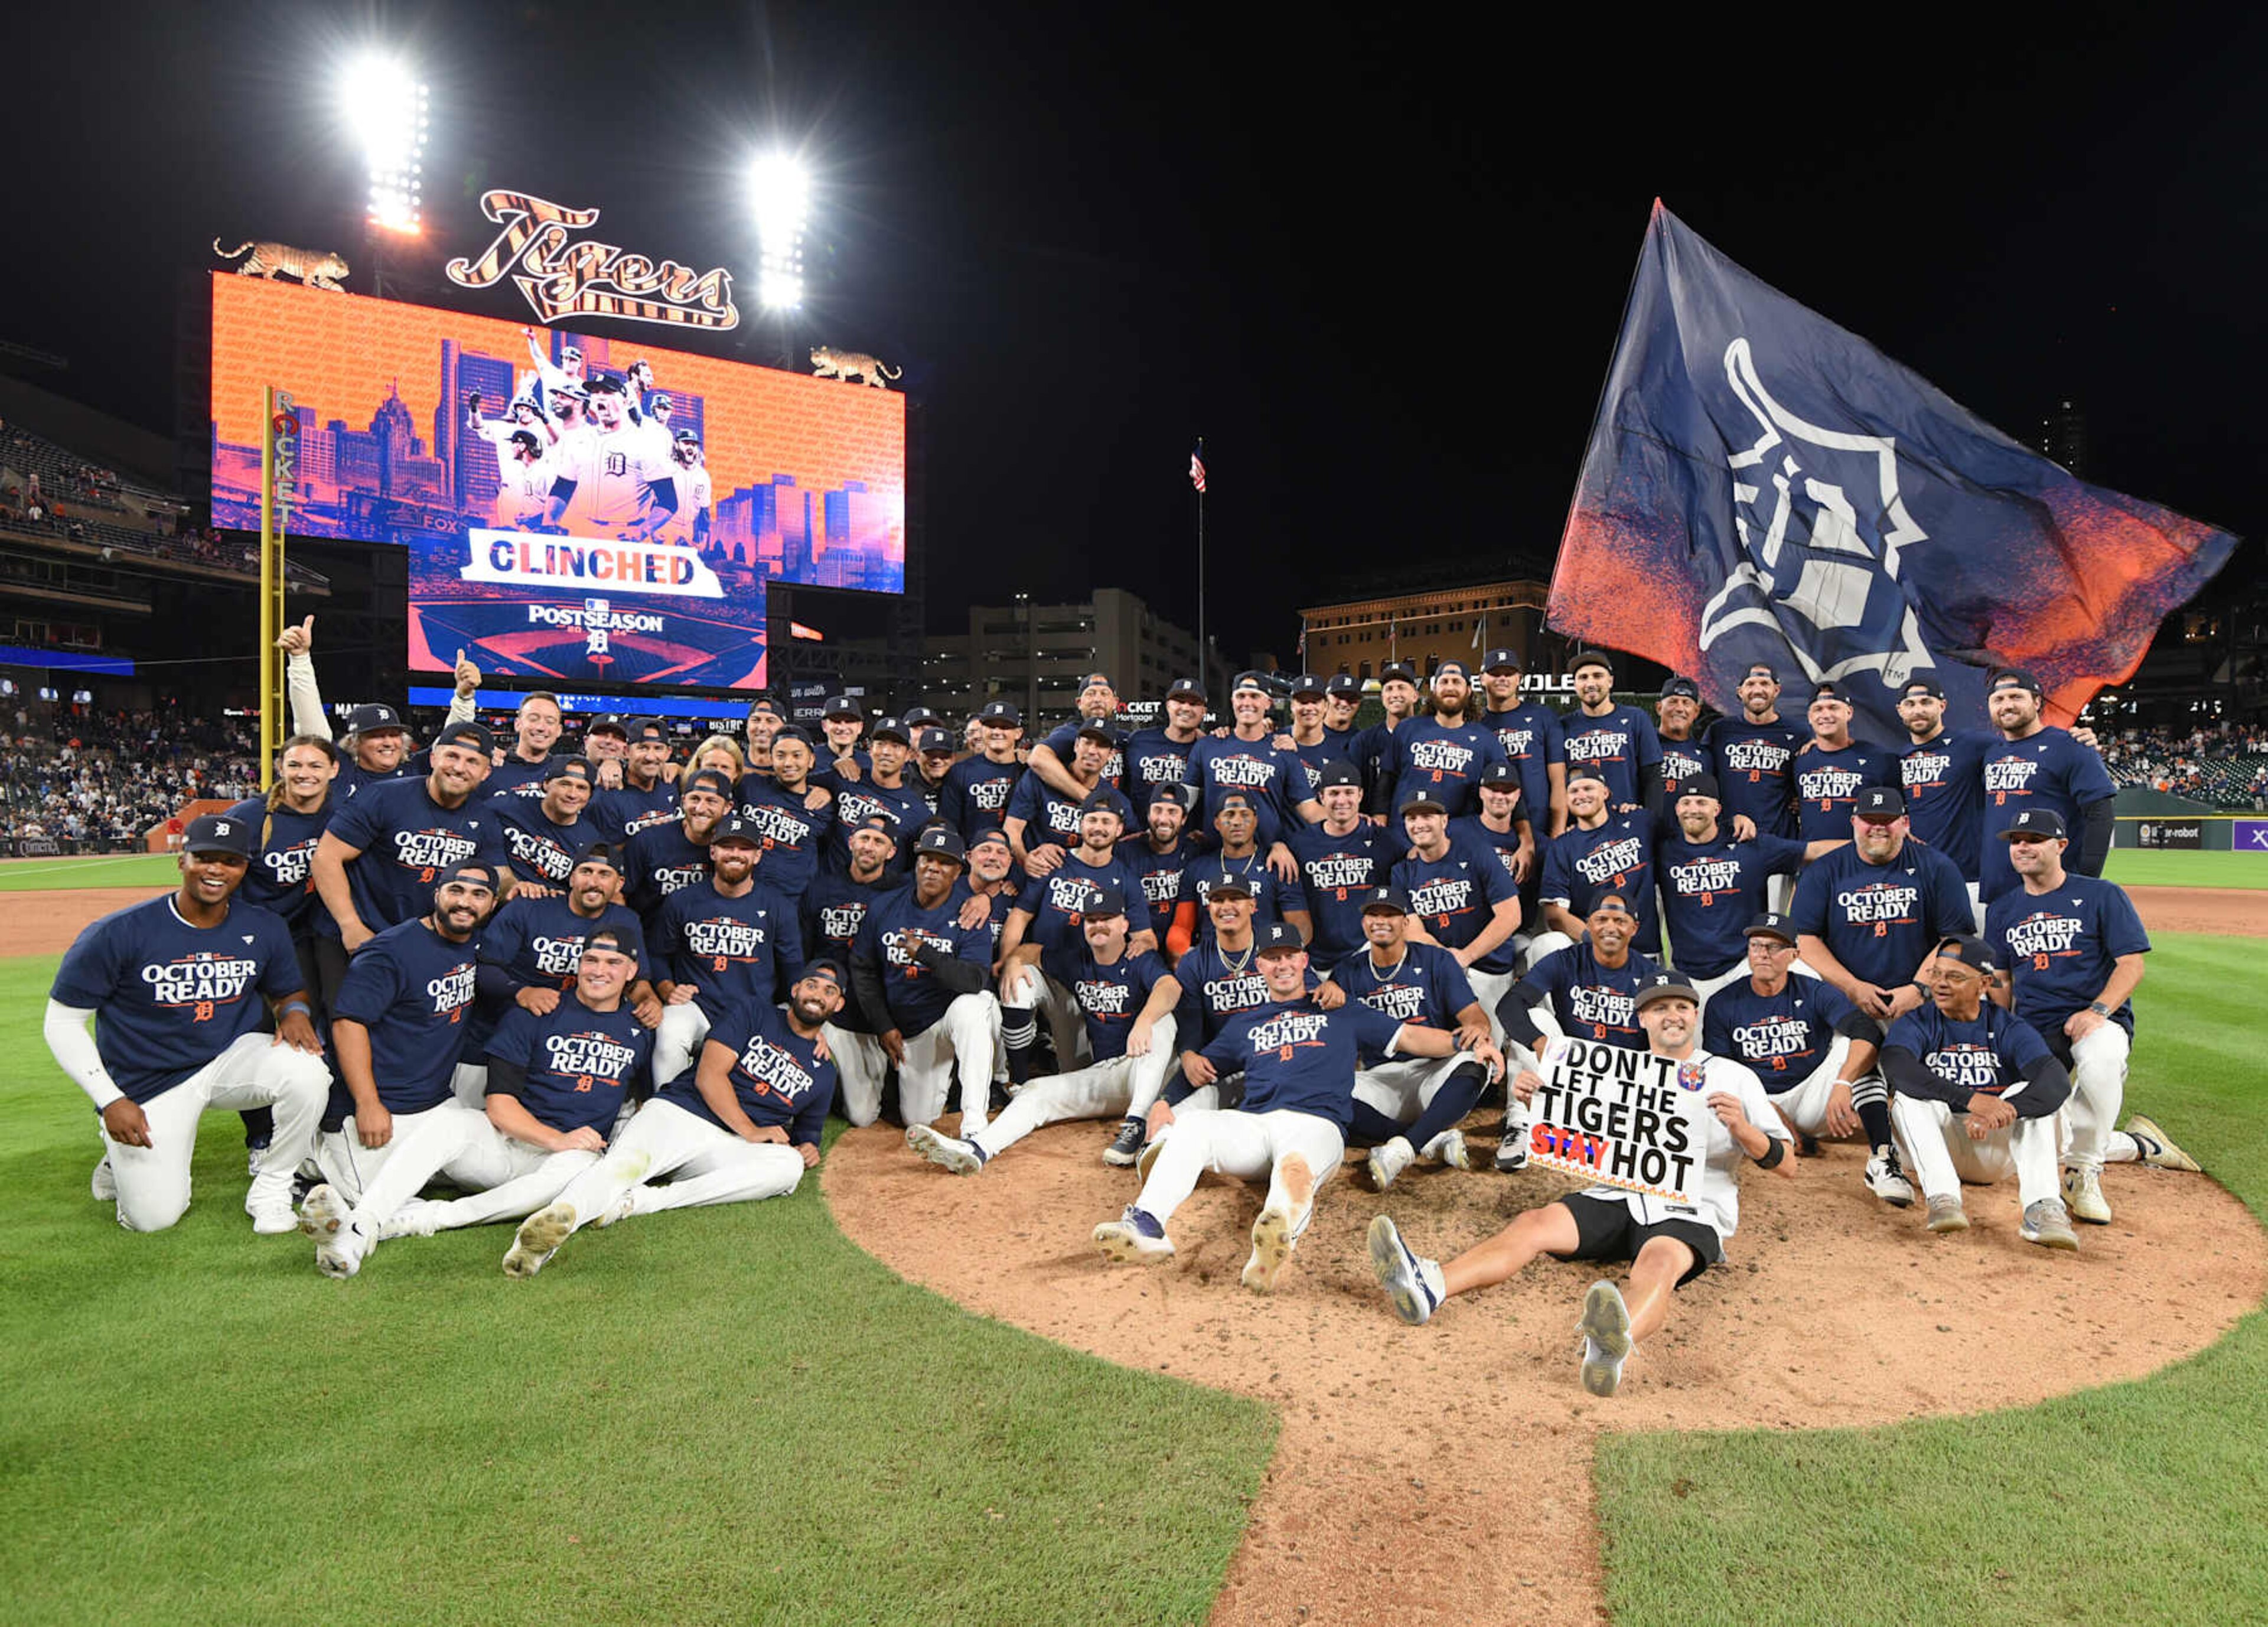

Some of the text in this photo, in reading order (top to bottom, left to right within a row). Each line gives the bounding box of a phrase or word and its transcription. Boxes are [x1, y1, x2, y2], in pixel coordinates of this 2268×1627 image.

[446, 190, 739, 331] Tigers
[273, 391, 299, 525] ROCKET
[423, 515, 457, 533] FOX
[488, 539, 695, 585] CLINCHED
[529, 604, 663, 633] POSTSEASON
[804, 685, 826, 697] with
[1114, 701, 1162, 713] OCKET
[1116, 713, 1153, 723] Mortgage
[1498, 730, 1533, 746] OBER
[1565, 733, 1628, 749] OCTOBER
[1410, 741, 1474, 762] OCTOBER
[1569, 744, 1623, 760] READY
[1725, 744, 1790, 761] OCTOBER
[1210, 757, 1276, 777] OCTOBER
[1413, 753, 1467, 772] READY
[1729, 756, 1784, 771] READY
[1143, 769, 1182, 782] READ
[1214, 769, 1270, 788] READY
[1799, 772, 1863, 786] OCTOBER
[969, 784, 1009, 796] OCTO
[1803, 783, 1857, 798] READY
[742, 804, 810, 837] OCTOBER
[1047, 801, 1083, 819] OCTO
[1049, 816, 1082, 833] REA
[395, 831, 476, 855] OCTOBER
[265, 847, 317, 868] OCTO
[1305, 857, 1374, 874] OCTOBER
[1576, 837, 1643, 873] OCTOBER
[655, 867, 703, 887] OCTO
[1585, 850, 1641, 885] READY
[1670, 859, 1741, 879] OCTOBER
[1050, 876, 1090, 897] OCTO
[1313, 870, 1369, 890] READY
[1677, 873, 1735, 894] READY
[1051, 891, 1084, 912] REA
[1413, 893, 1469, 917] READY
[1838, 887, 1917, 907] OCTOBER
[821, 907, 865, 923] OCTO
[1846, 903, 1911, 923] READY
[684, 922, 764, 943] OCTOBER
[2006, 919, 2084, 943] OCTOBER
[533, 936, 584, 958] OCTO
[690, 936, 757, 956] READY
[2013, 933, 2075, 959] READY
[142, 960, 257, 983] OCTOBER
[536, 952, 579, 975] REA
[155, 977, 247, 1003] READY
[427, 965, 477, 997] OCTOBE
[1203, 974, 1266, 997] OCTOBE
[434, 982, 475, 1013] READ
[1572, 1001, 1633, 1027] READY
[1247, 1013, 1328, 1040] OCTOBER
[1732, 1020, 1811, 1043] OCTOBER
[1254, 1026, 1321, 1052] READY
[1741, 1035, 1807, 1059] READY
[546, 1035, 636, 1065] OCTOBER
[550, 1052, 627, 1081] READY
[747, 1034, 814, 1094] OCTOBER
[1566, 1039, 1675, 1087] DON'T
[740, 1051, 805, 1101] READY
[1552, 1066, 1677, 1115] LET THE
[1539, 1086, 1689, 1153] TIGERS
[1529, 1123, 1694, 1192] STAY HOT
